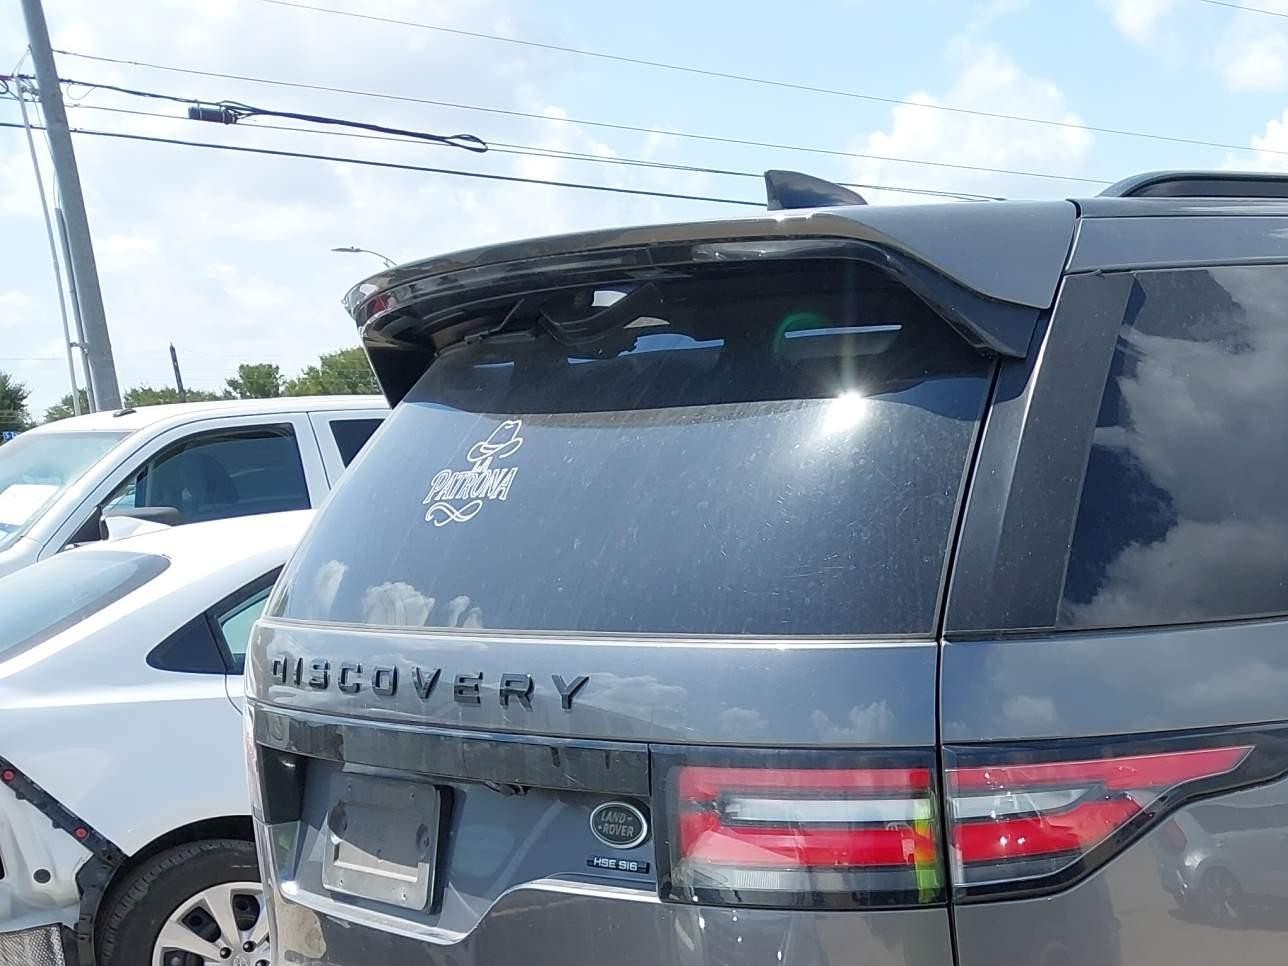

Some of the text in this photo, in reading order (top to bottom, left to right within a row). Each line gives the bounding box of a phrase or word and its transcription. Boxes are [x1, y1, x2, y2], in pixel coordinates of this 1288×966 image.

[472, 456, 493, 472] LA
[423, 467, 519, 504] PATRONA
[271, 655, 590, 713] DISCOVERY
[602, 823, 634, 837] ROVER
[593, 857, 617, 869] HSE
